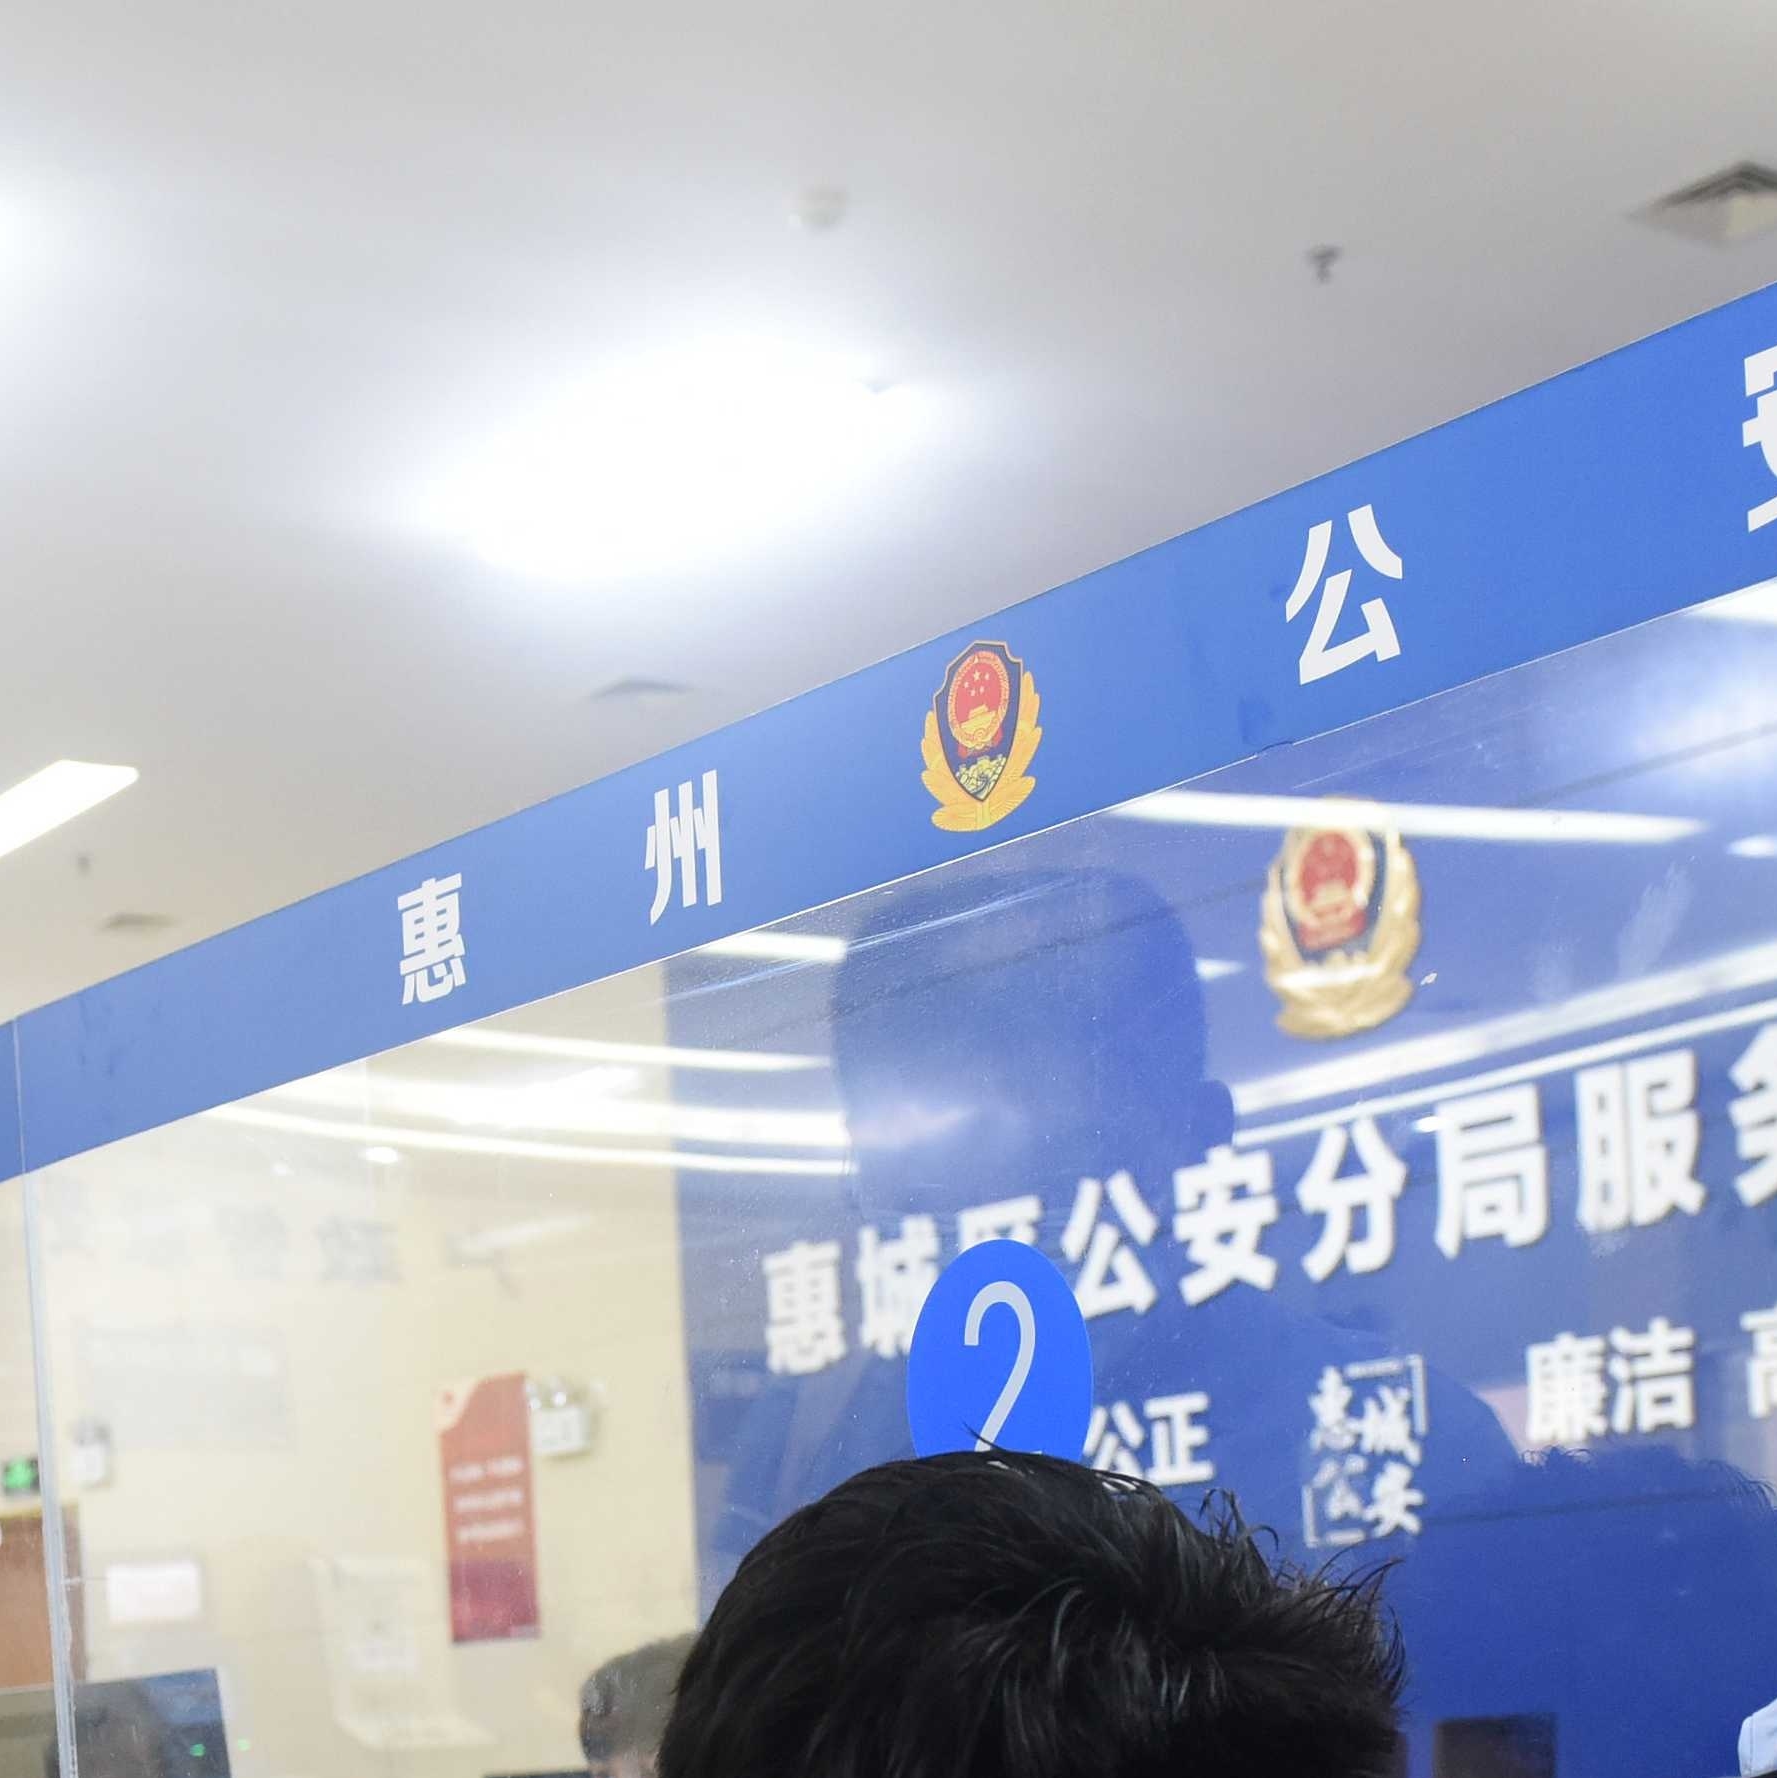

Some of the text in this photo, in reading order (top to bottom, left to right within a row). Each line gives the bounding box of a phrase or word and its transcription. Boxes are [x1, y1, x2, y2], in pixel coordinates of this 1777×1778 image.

[397, 769, 721, 1006] 惠州
[963, 1280, 1044, 1470] 2
[1525, 1316, 1698, 1445] 廉洁
